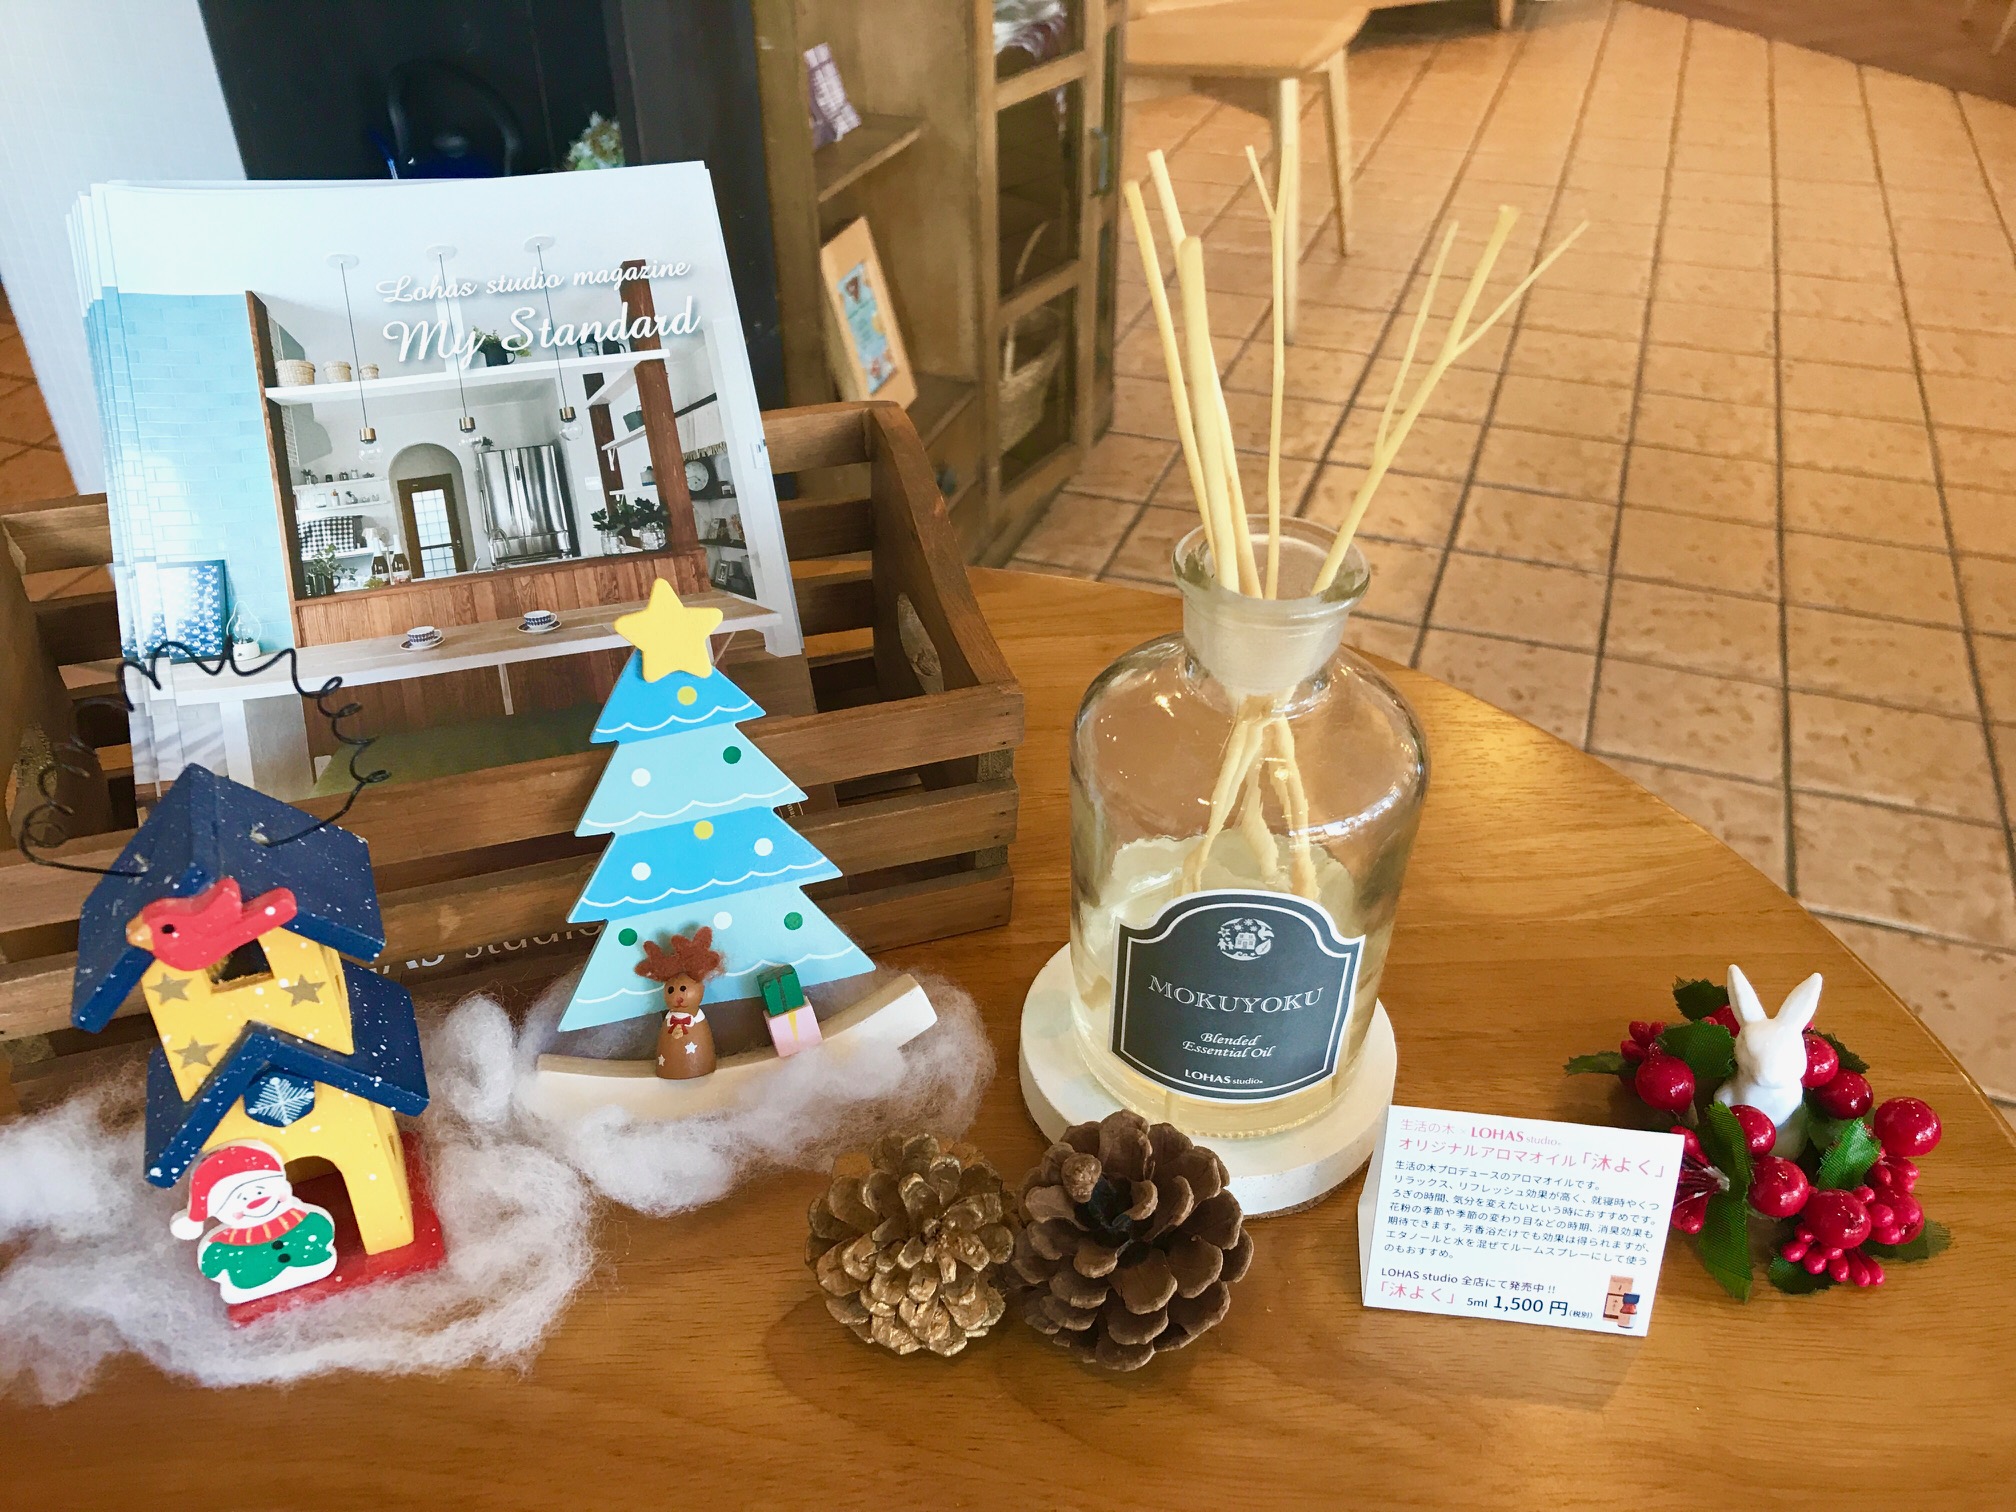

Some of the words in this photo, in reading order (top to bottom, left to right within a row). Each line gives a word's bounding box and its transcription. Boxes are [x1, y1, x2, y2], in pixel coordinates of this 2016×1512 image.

[375, 274, 477, 304] Lohas
[485, 265, 565, 295] studio
[572, 259, 691, 292] magazine
[382, 319, 486, 370] My
[501, 296, 701, 352] Standard
[1148, 975, 1324, 1014] MOKUYOKU
[1200, 1032, 1261, 1047] Blended
[1182, 1040, 1250, 1058] Essential
[1252, 1046, 1275, 1059] Oil
[1185, 1069, 1231, 1084] LOHAS
[1400, 1118, 1455, 1135] 生活の木
[1471, 1126, 1524, 1143] LOHAS
[1384, 1243, 1454, 1259] のもおすすめ。
[1381, 1267, 1420, 1280] LOHAS
[1422, 1271, 1458, 1284] studio
[1467, 1297, 1488, 1308] 5ml
[1493, 1295, 1544, 1312] 1,500
